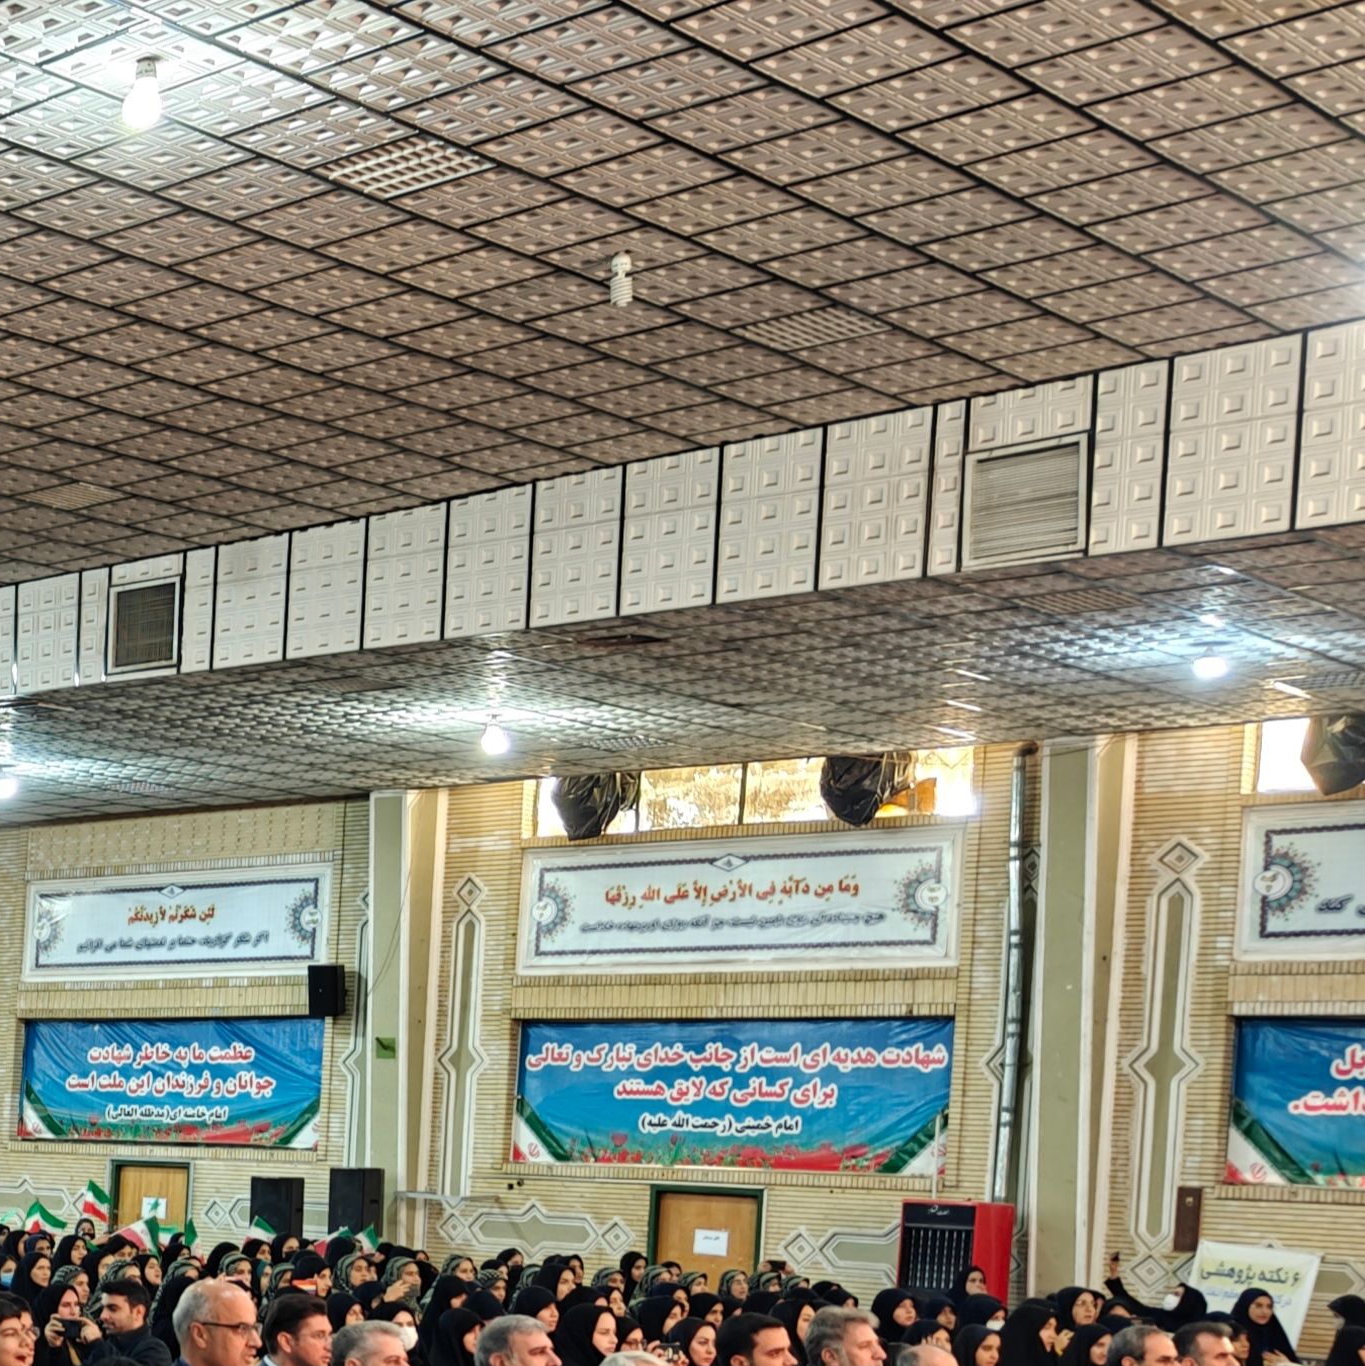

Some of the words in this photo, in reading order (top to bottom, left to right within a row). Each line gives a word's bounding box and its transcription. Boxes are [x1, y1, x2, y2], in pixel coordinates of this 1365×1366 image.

[89, 1047, 132, 1065] شهادت
[135, 1046, 171, 1067] خاطر
[175, 1049, 189, 1068] به
[192, 1047, 205, 1062] ما
[208, 1045, 253, 1062] عظمت
[527, 1045, 572, 1070] تعالی
[572, 1052, 584, 1069] و
[585, 1045, 635, 1071] تبارک
[635, 1045, 686, 1071] خدای
[689, 1046, 735, 1071] جانب
[737, 1045, 756, 1071] از
[759, 1046, 799, 1065] است
[802, 1045, 831, 1070] ای
[831, 1050, 877, 1070] هدیه
[881, 1045, 946, 1069] شهادت
[67, 1075, 96, 1090] است
[98, 1075, 125, 1090] ملت
[128, 1074, 151, 1095] این
[154, 1073, 210, 1096] فرزندان
[212, 1080, 221, 1096] و
[225, 1074, 274, 1097] جوانان
[615, 1080, 667, 1099] هستند
[668, 1079, 705, 1103] لایق
[707, 1079, 731, 1098] که
[732, 1077, 790, 1104] کسانی
[793, 1078, 836, 1105] برای
[209, 1107, 226, 1123] امام
[671, 1113, 690, 1127] الله
[735, 1115, 772, 1132] خمینی
[775, 1115, 799, 1133] امام
[1200, 1259, 1257, 1286] پژوهشی
[1257, 1266, 1290, 1285] نکته
